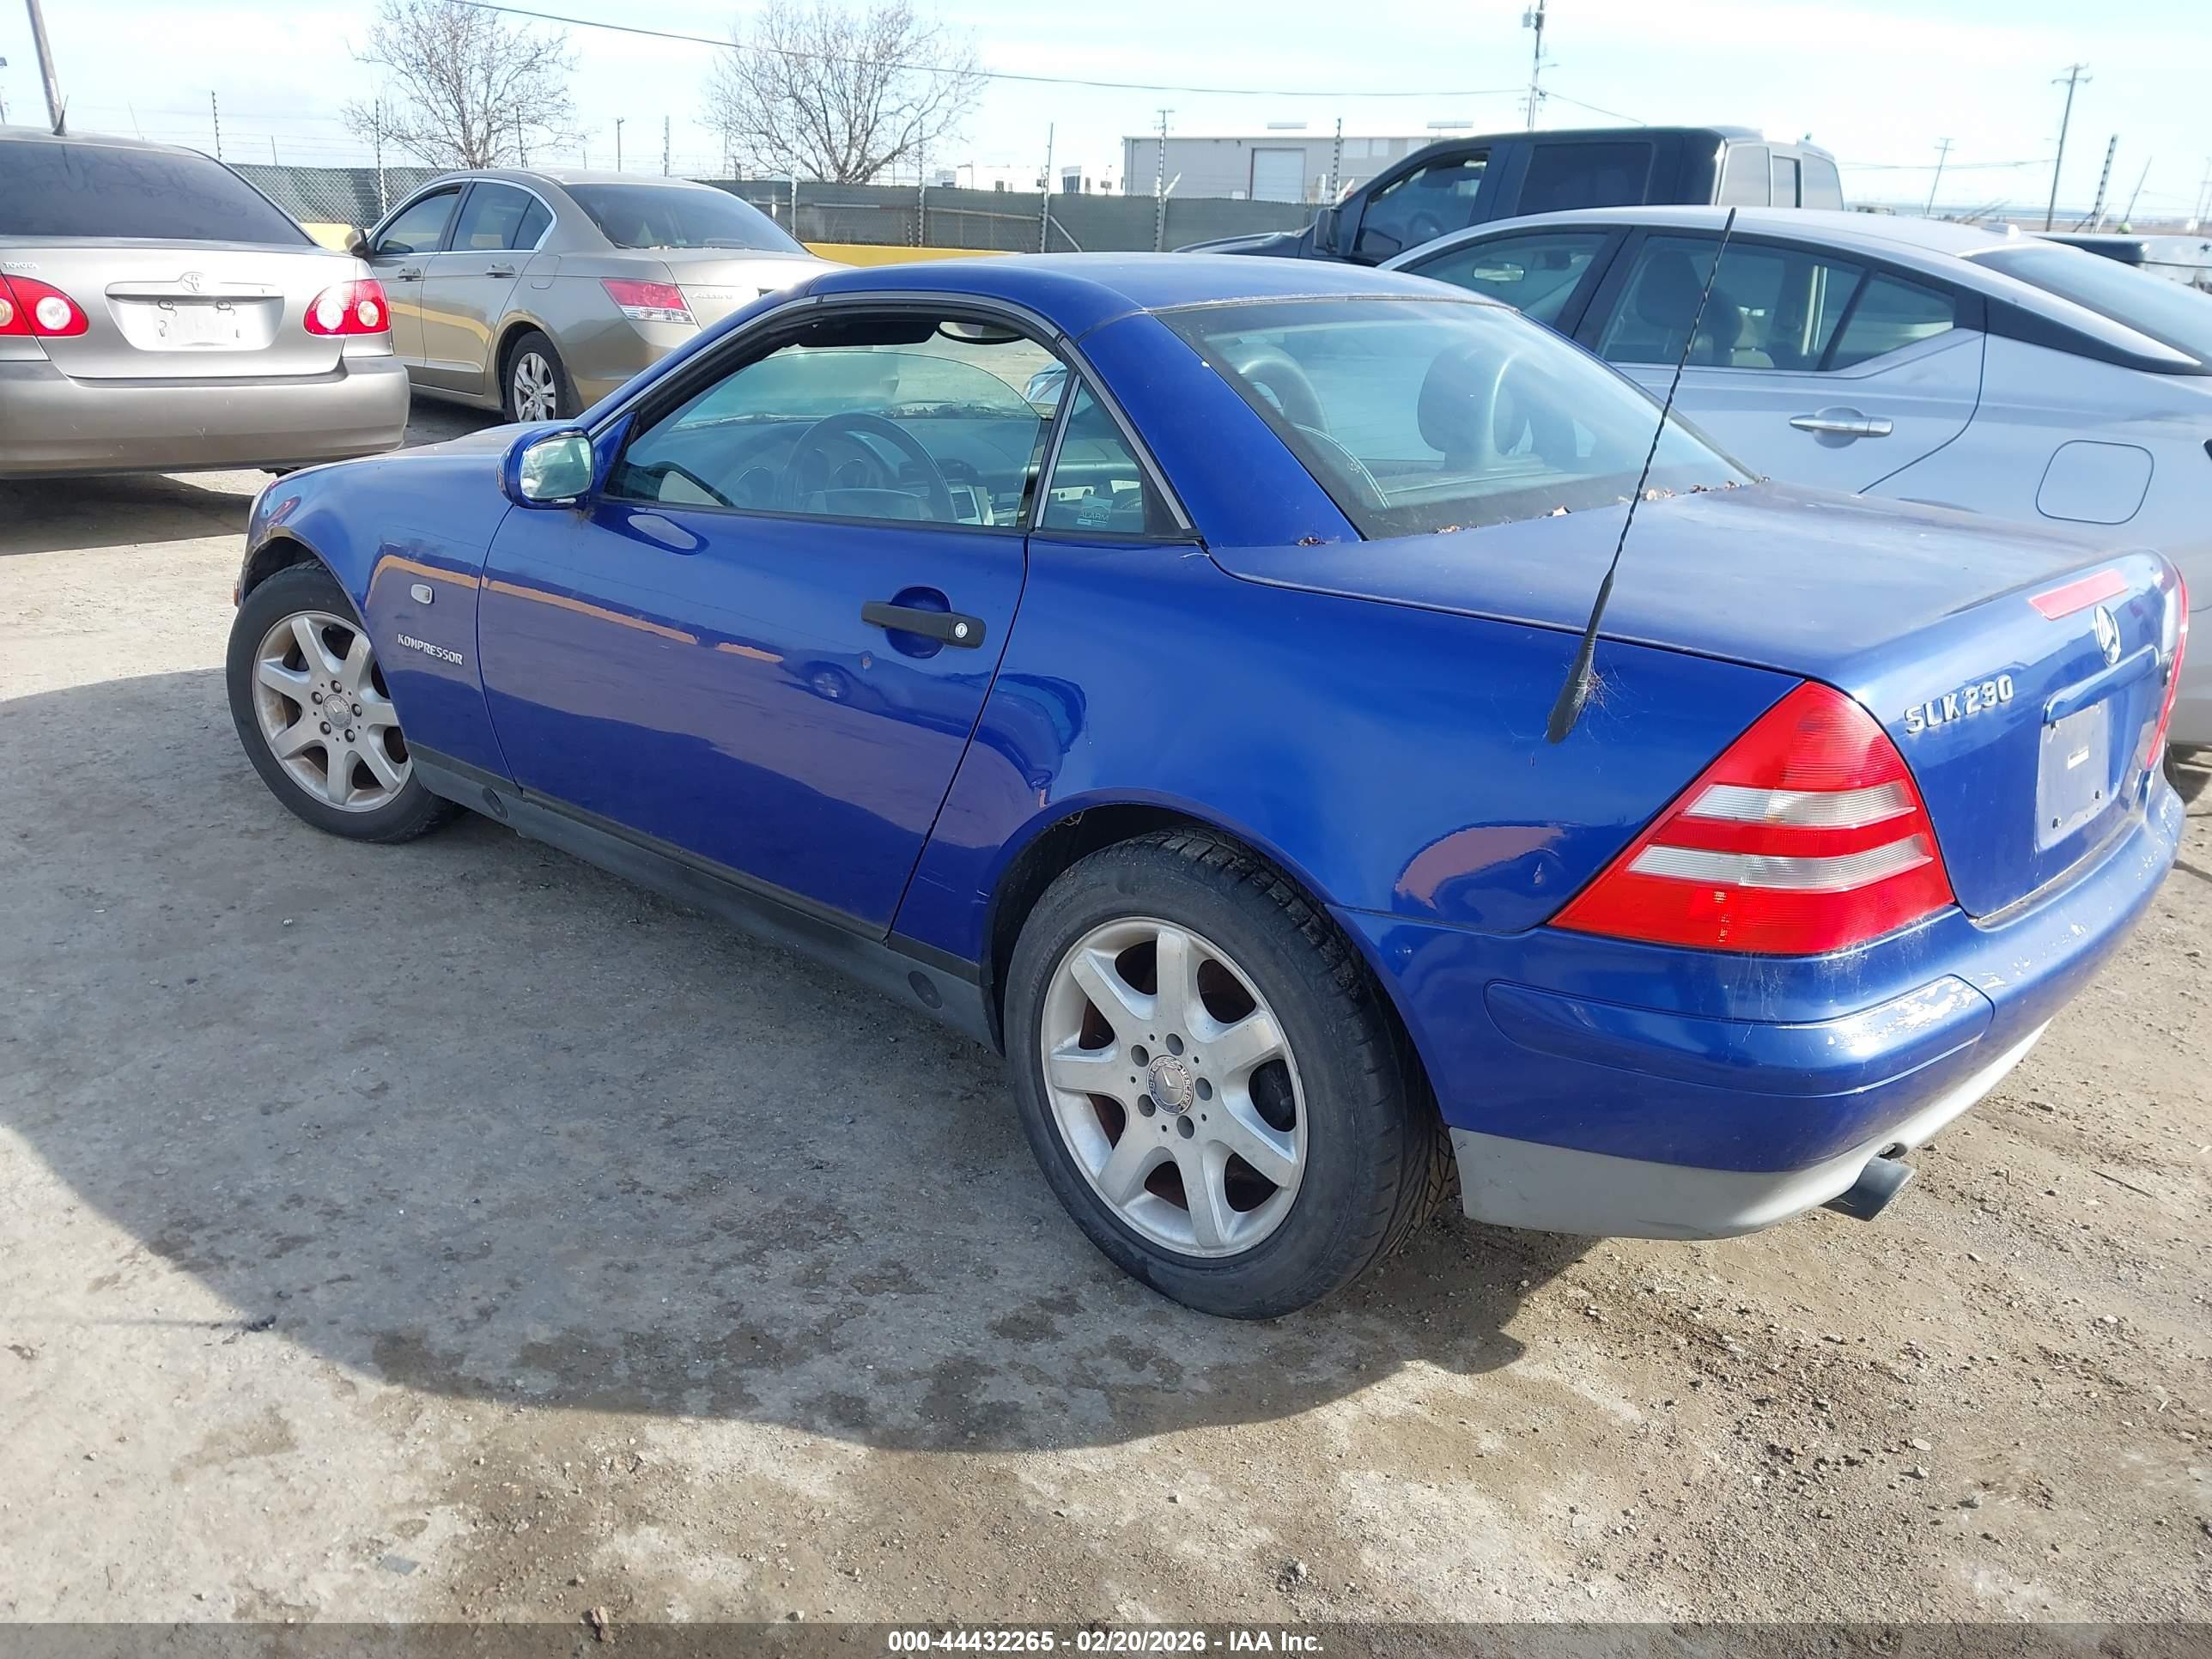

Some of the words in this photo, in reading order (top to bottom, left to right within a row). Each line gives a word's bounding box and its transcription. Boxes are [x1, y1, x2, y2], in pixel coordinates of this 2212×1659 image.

[1079, 511, 1109, 521] ALARM
[398, 633, 463, 665] KOMPRESSOR
[1903, 693, 1961, 734] SLK
[1961, 673, 2014, 715] 230
[1179, 1067, 1192, 1109] MERCEDES
